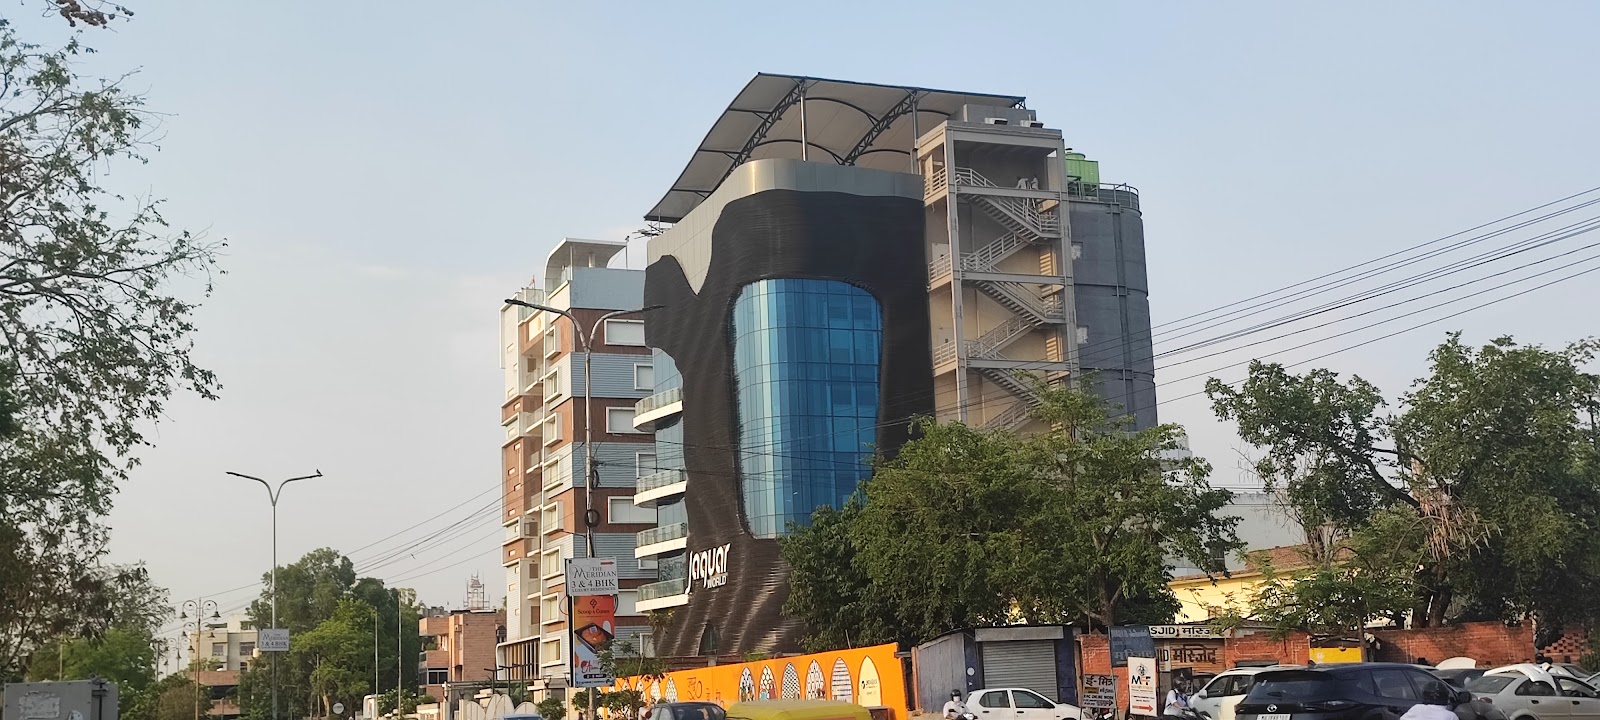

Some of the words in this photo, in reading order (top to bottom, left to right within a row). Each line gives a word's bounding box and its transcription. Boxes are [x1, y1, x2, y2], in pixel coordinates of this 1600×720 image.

[571, 566, 617, 580] MERIDIAN
[595, 579, 616, 587] BHK
[707, 575, 727, 589] WORLD
[1150, 626, 1176, 635] SJID
